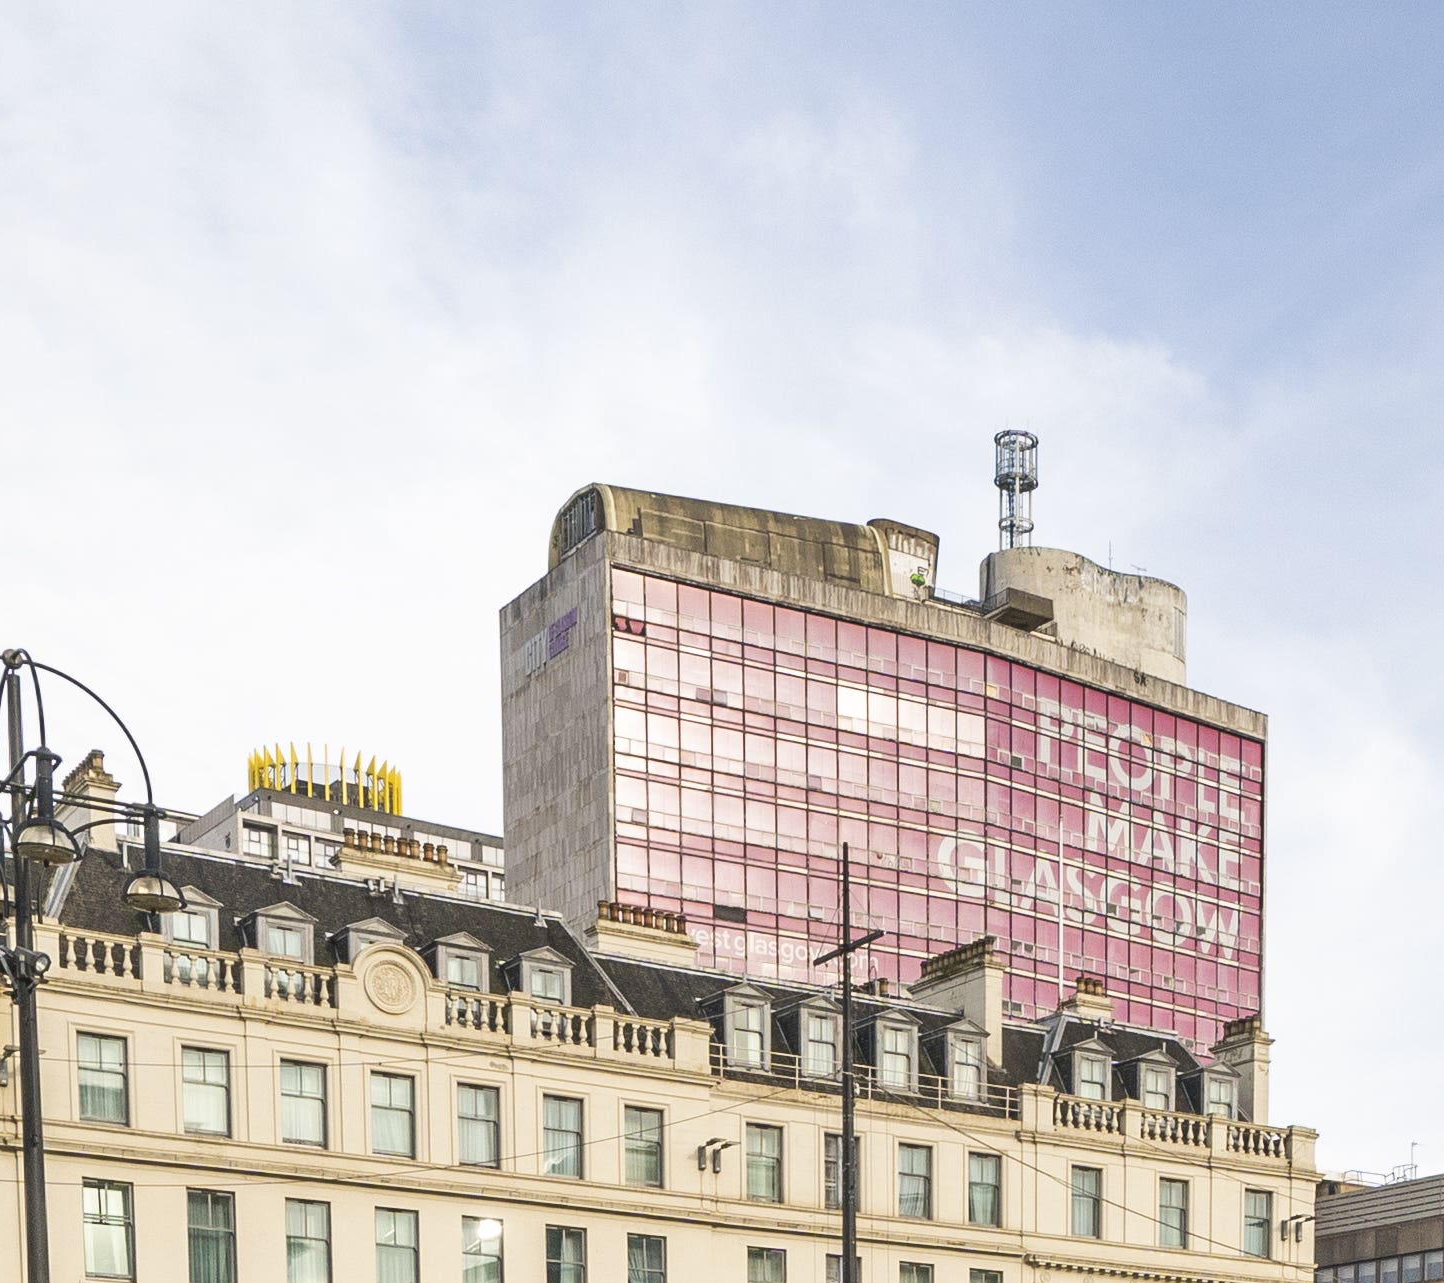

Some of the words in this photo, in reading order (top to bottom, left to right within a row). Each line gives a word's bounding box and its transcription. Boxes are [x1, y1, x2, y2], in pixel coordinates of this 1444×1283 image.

[1039, 696, 1245, 820] PEOPLE
[936, 829, 1242, 962] GLASGOW
[1087, 791, 1245, 891] MAKE
